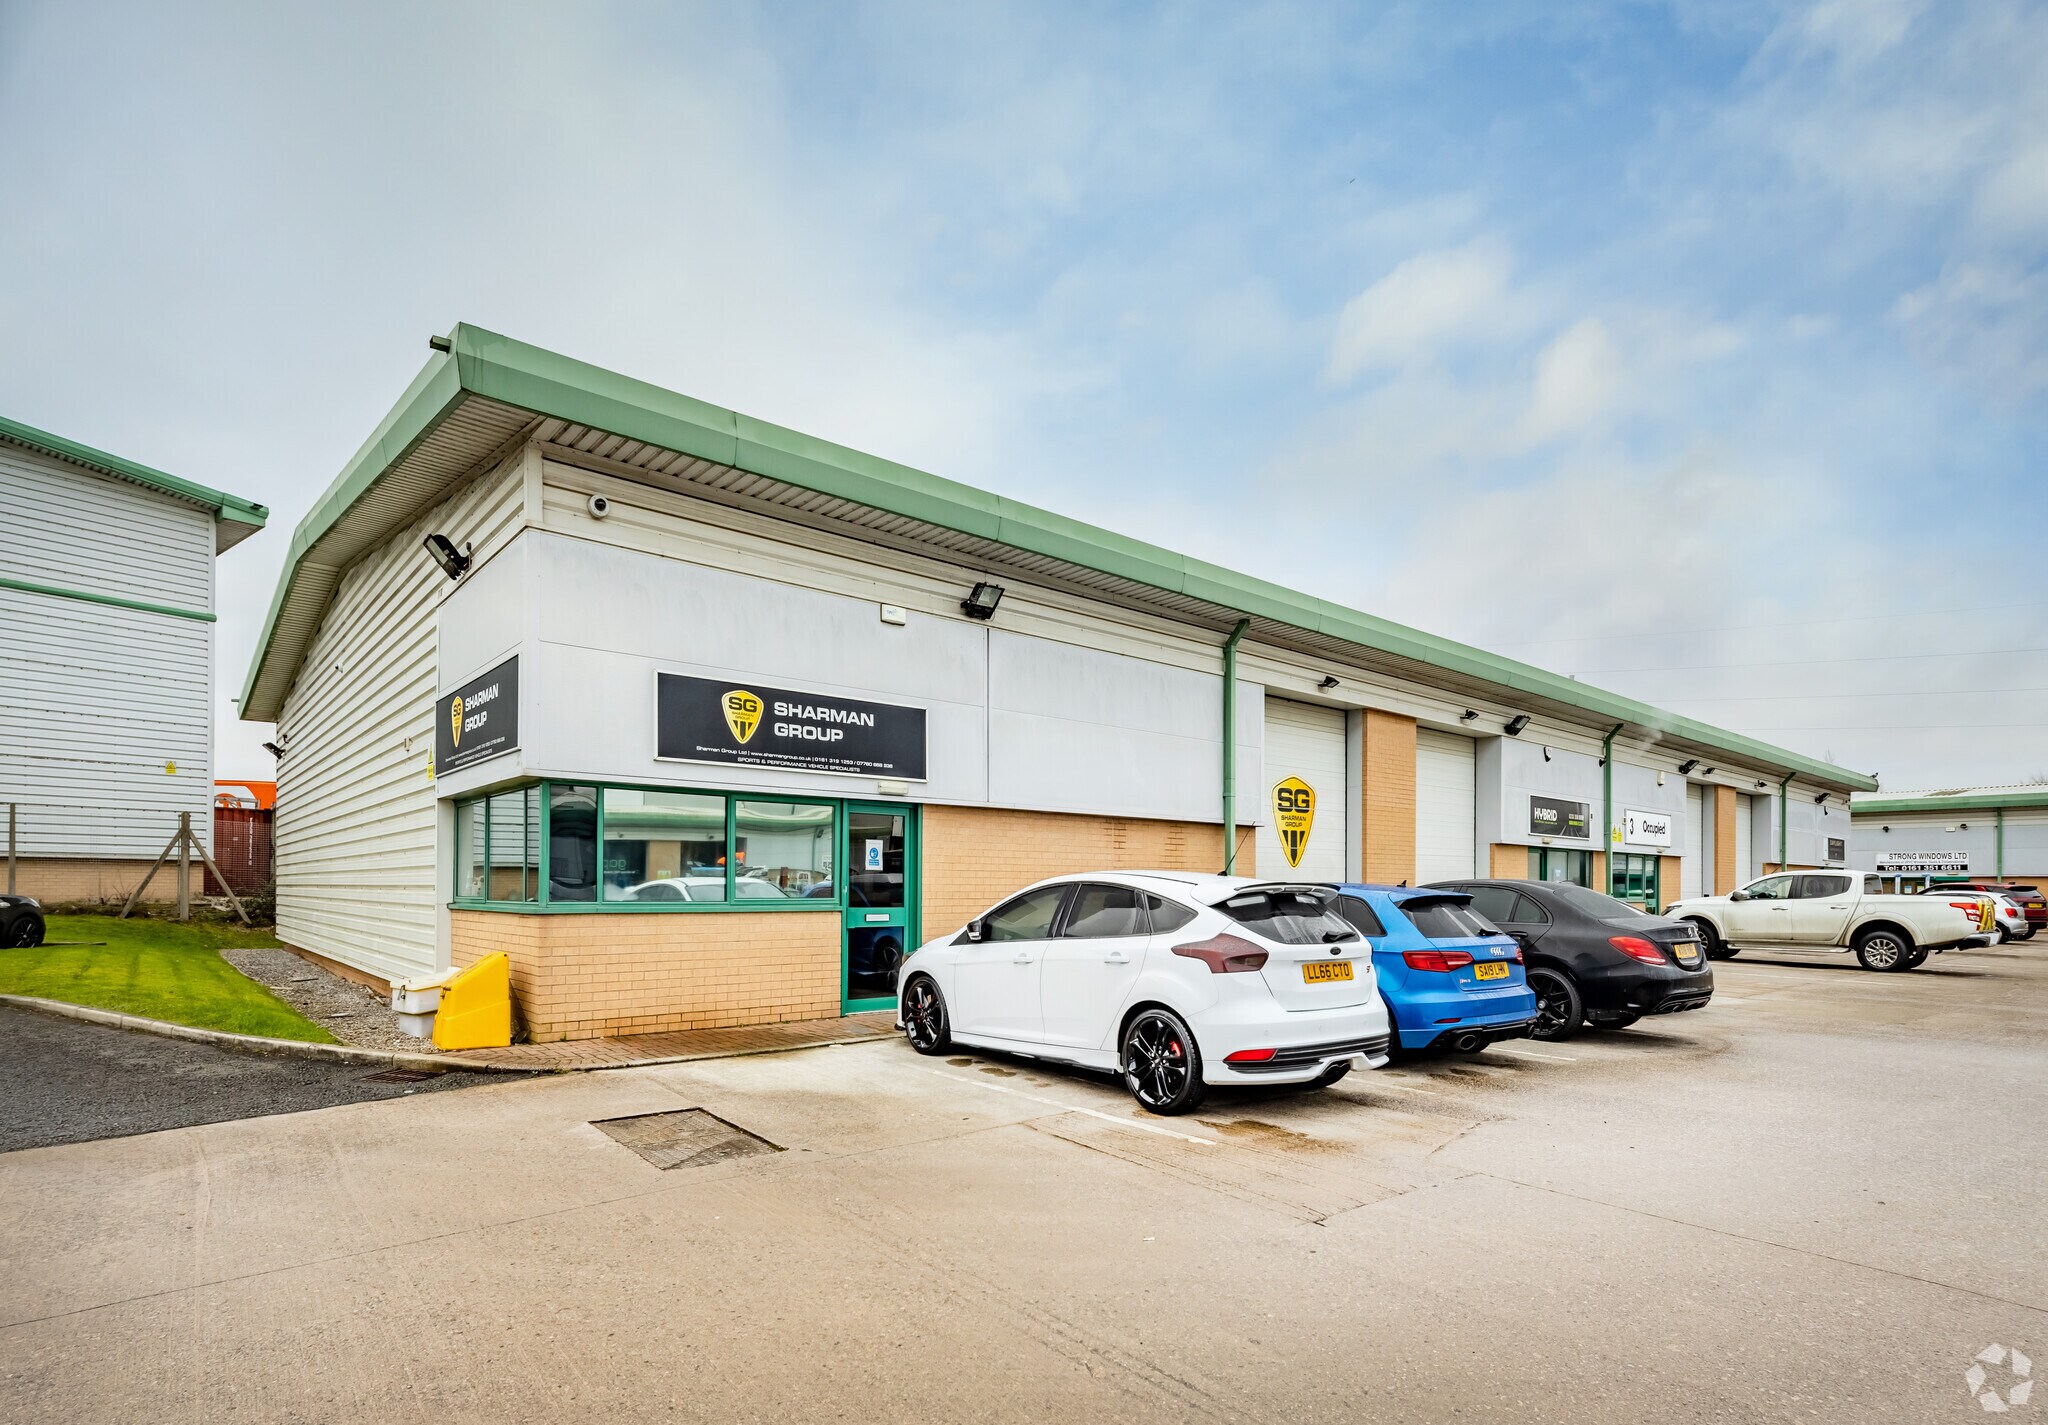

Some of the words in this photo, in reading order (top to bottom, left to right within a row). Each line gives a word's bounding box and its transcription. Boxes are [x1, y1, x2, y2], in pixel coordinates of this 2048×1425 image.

[465, 683, 499, 712] SHARMAN
[728, 696, 758, 713] SG
[453, 703, 461, 717] SG
[774, 701, 875, 727] SHARMAN
[465, 710, 488, 732] GROUP
[774, 722, 844, 742] GROUP
[696, 745, 720, 753] Sharman
[737, 756, 760, 764] SPORTS
[767, 759, 807, 768] PERFORMANCE
[829, 765, 861, 773] SPECIALISTS
[1277, 787, 1310, 813] SG
[1534, 807, 1558, 822] HYBRID
[1629, 817, 1634, 835] 3
[1642, 820, 1666, 837] Occupied
[1888, 852, 1917, 860] STRONG
[1918, 852, 1952, 860] WINDOWS
[1954, 852, 1967, 860] LTD
[1307, 964, 1331, 980] LL66
[1332, 963, 1350, 978] CTO
